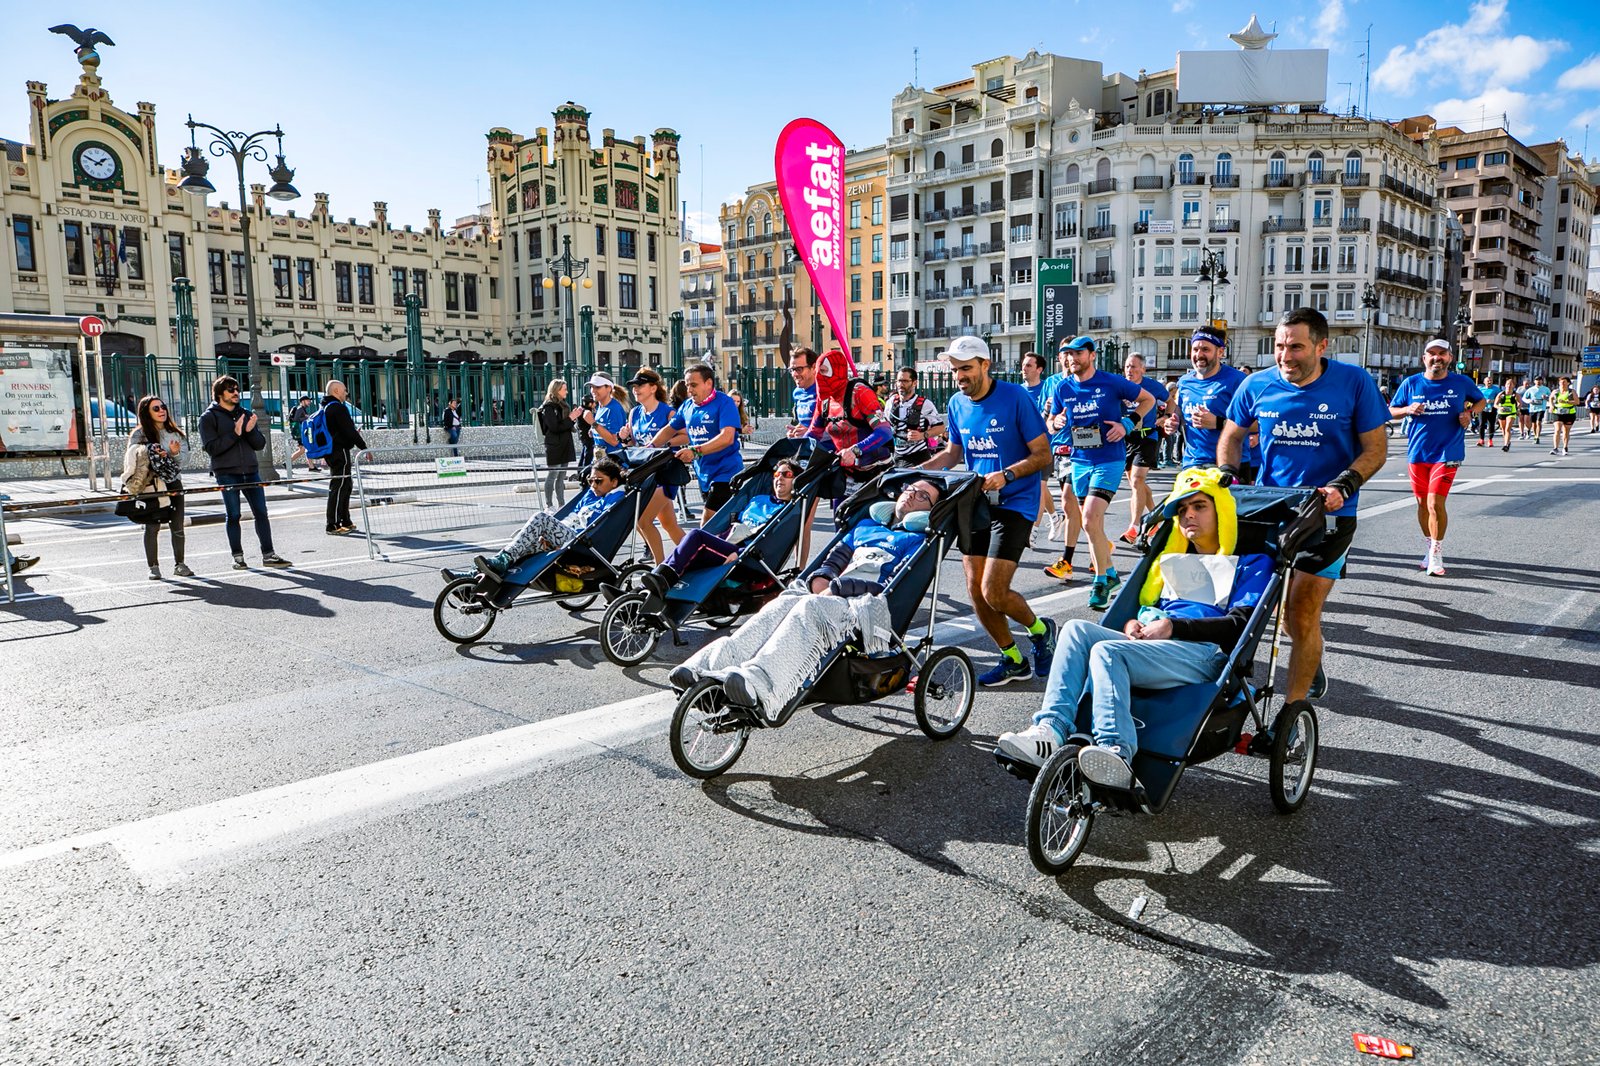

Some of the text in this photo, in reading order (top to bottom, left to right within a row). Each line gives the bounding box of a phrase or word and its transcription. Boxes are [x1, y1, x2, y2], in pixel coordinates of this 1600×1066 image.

[847, 182, 874, 196] ZENIT
[803, 142, 833, 266] aefat
[830, 146, 840, 270] www.aefat.es
[99, 211, 119, 221] DEL
[120, 213, 147, 223] NORD
[1055, 303, 1064, 326] NORD
[89, 323, 103, 333] m
[1309, 412, 1337, 420] ZURICH
